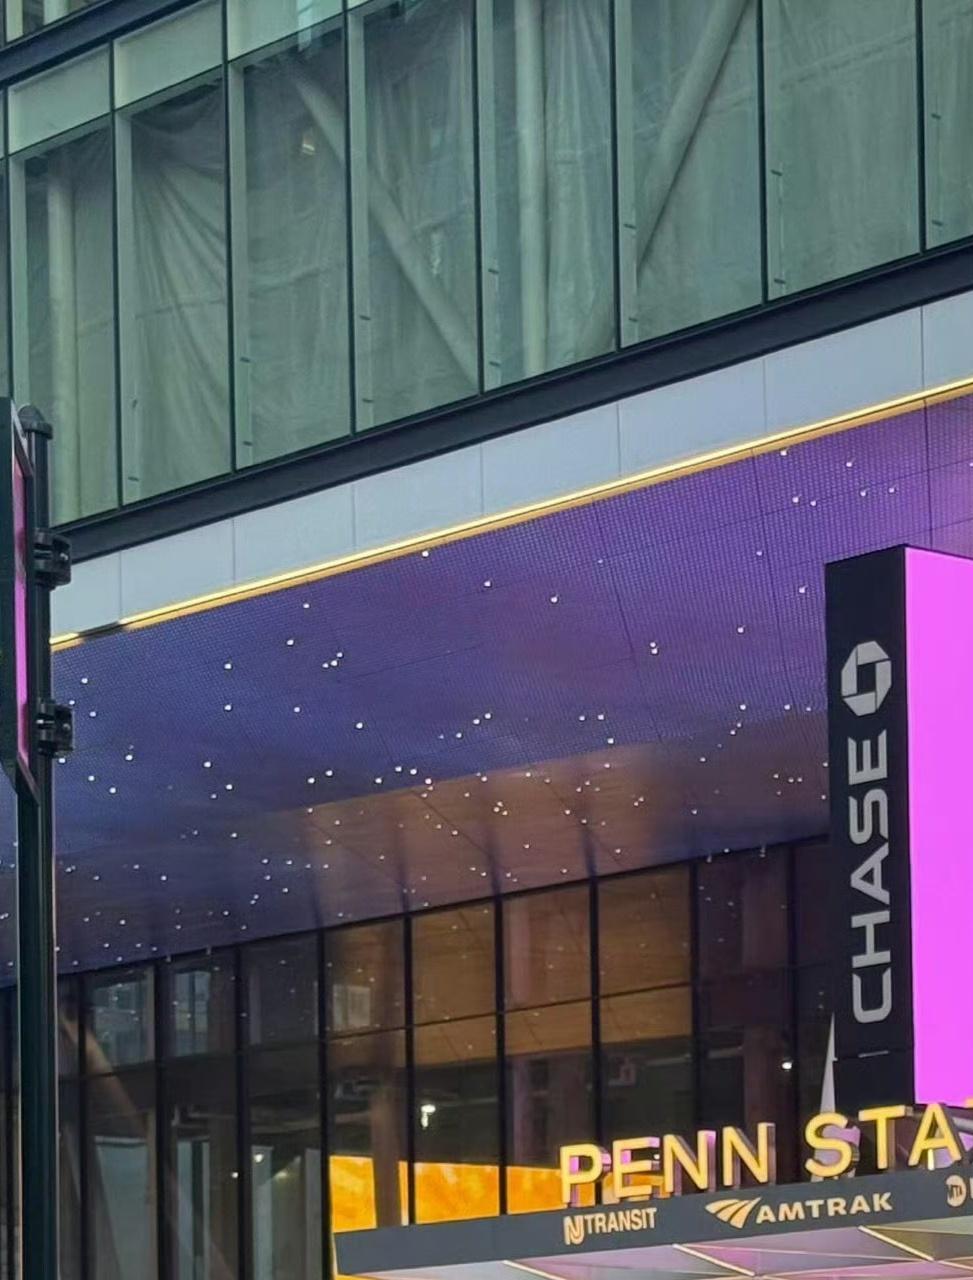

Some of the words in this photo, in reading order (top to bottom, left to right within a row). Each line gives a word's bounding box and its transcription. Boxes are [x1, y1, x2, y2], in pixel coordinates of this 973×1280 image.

[847, 729, 892, 1024] CHASE
[560, 1122, 776, 1206] PENN
[584, 1207, 657, 1235] TRANSIT
[755, 1193, 893, 1225] AMTRAK
